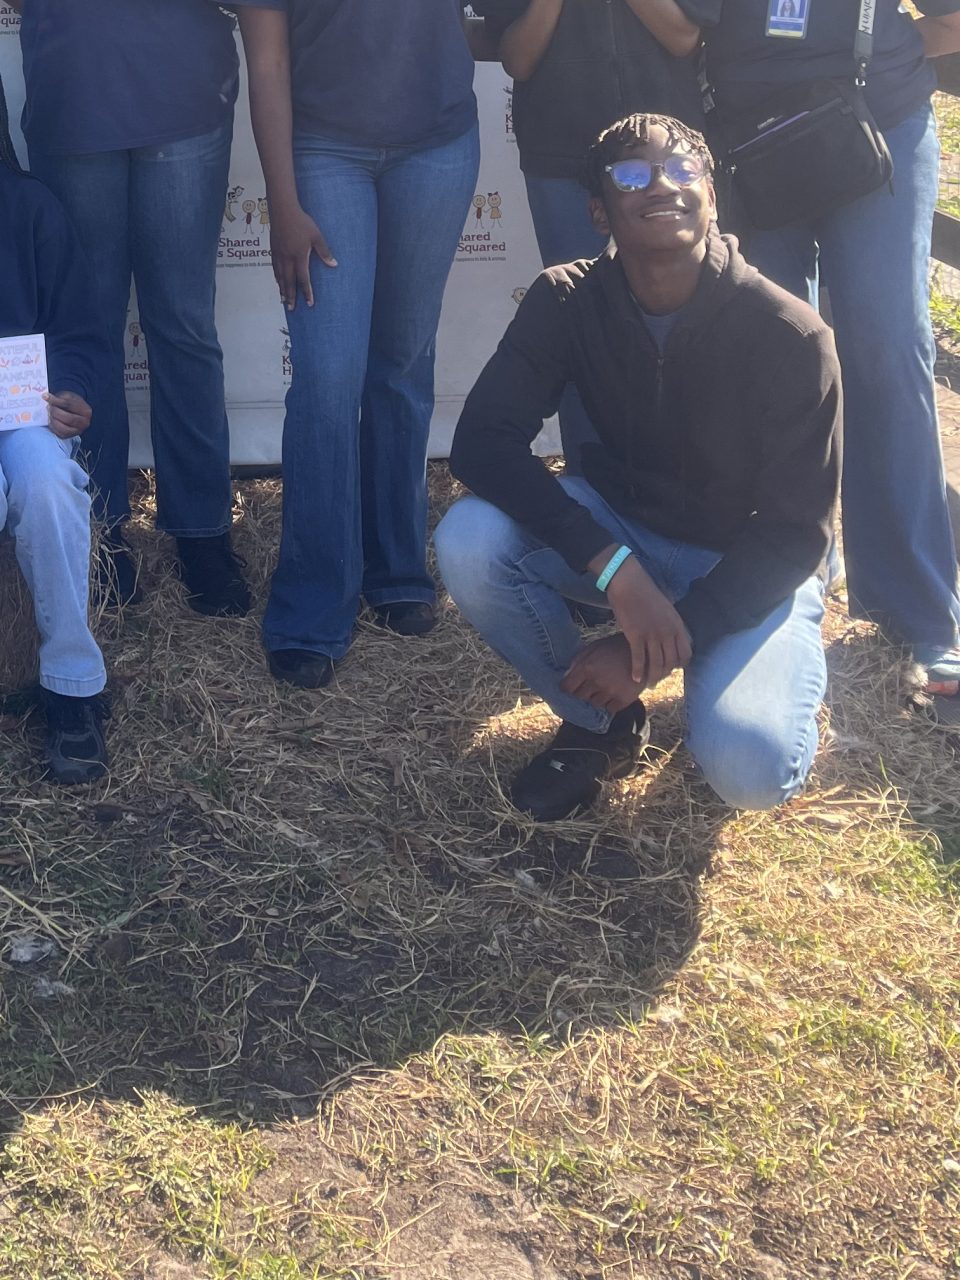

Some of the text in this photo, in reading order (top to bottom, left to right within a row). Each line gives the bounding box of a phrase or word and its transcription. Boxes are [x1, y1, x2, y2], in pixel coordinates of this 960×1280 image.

[461, 231, 491, 241] ared
[219, 237, 260, 247] Shared
[457, 241, 506, 254] Squared
